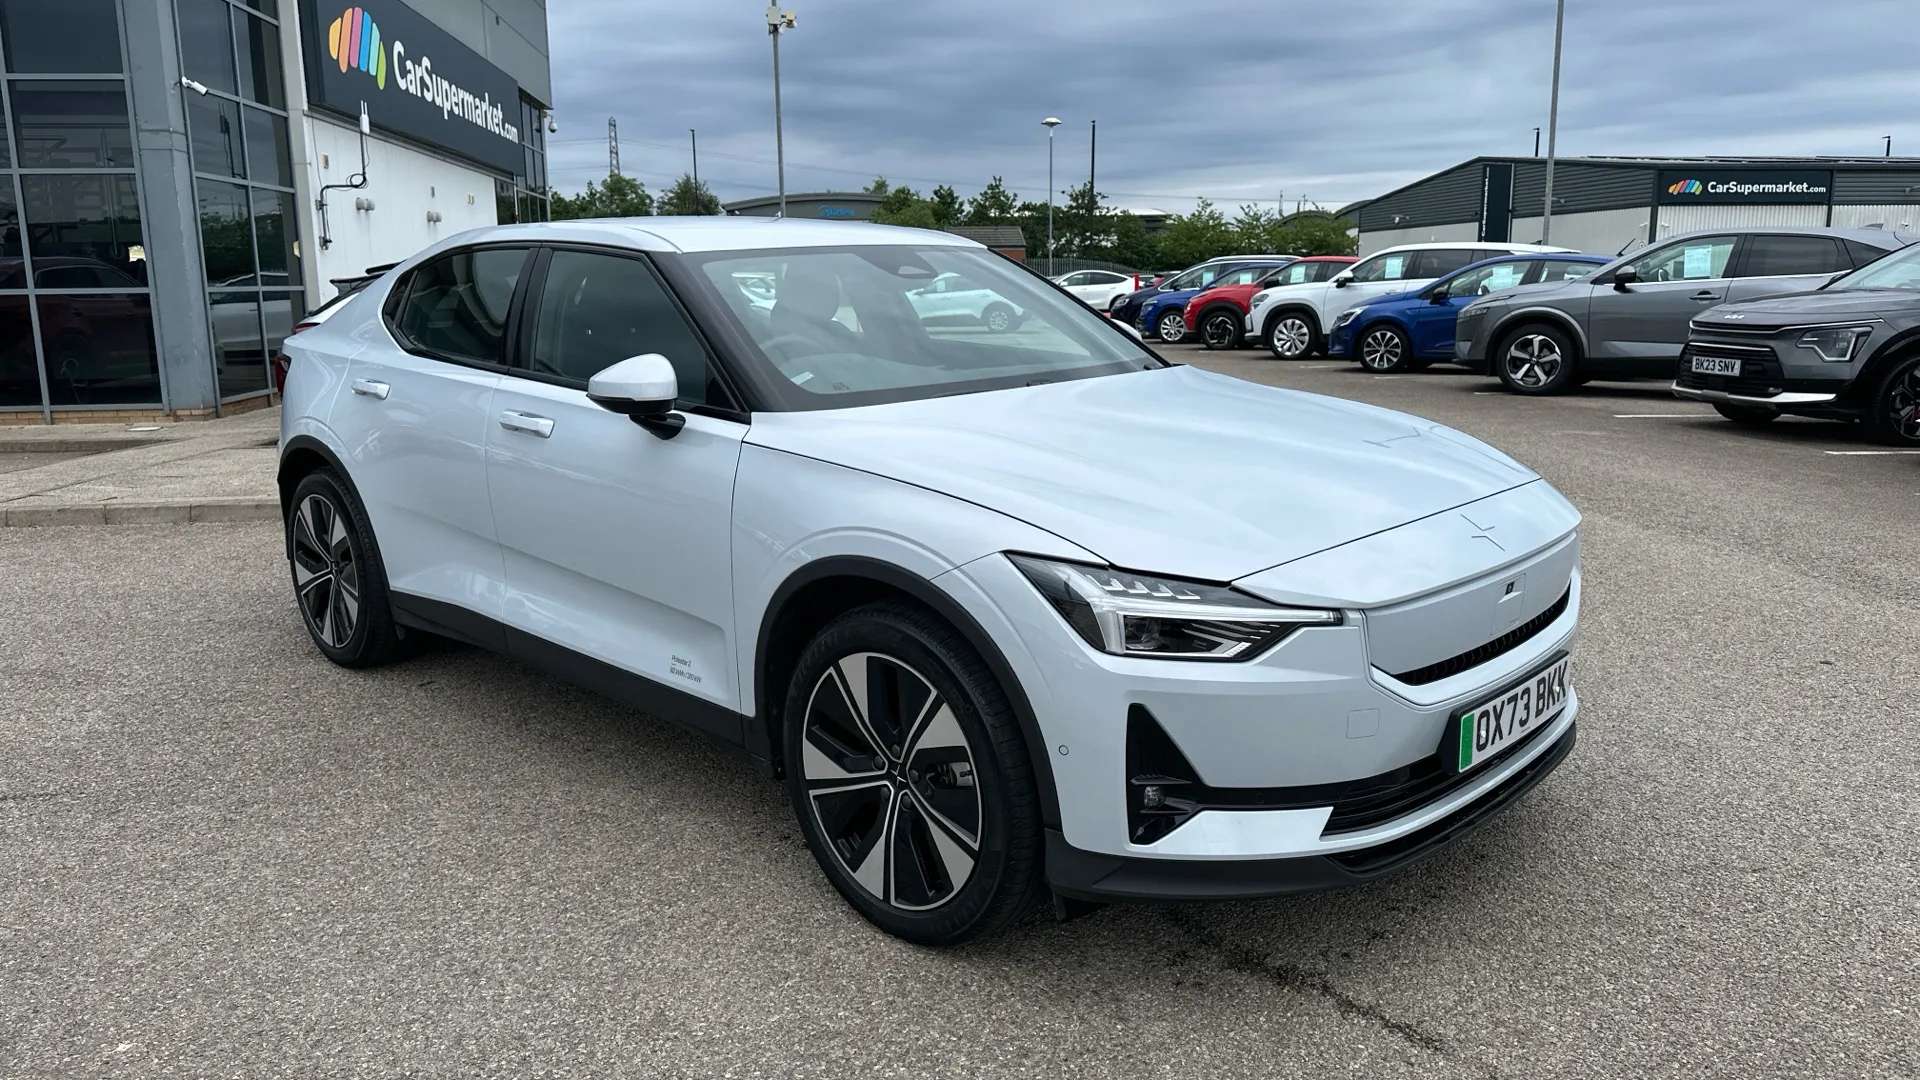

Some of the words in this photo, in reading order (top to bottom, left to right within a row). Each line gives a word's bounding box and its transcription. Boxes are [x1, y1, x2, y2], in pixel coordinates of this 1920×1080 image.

[393, 40, 519, 144] CarSupermarket.com
[1707, 181, 1827, 195] CarSupermarket.com
[1695, 357, 1716, 371] BK23
[1717, 359, 1736, 372] SNV
[1475, 686, 1531, 753] OX73
[1534, 660, 1568, 719] BKK
